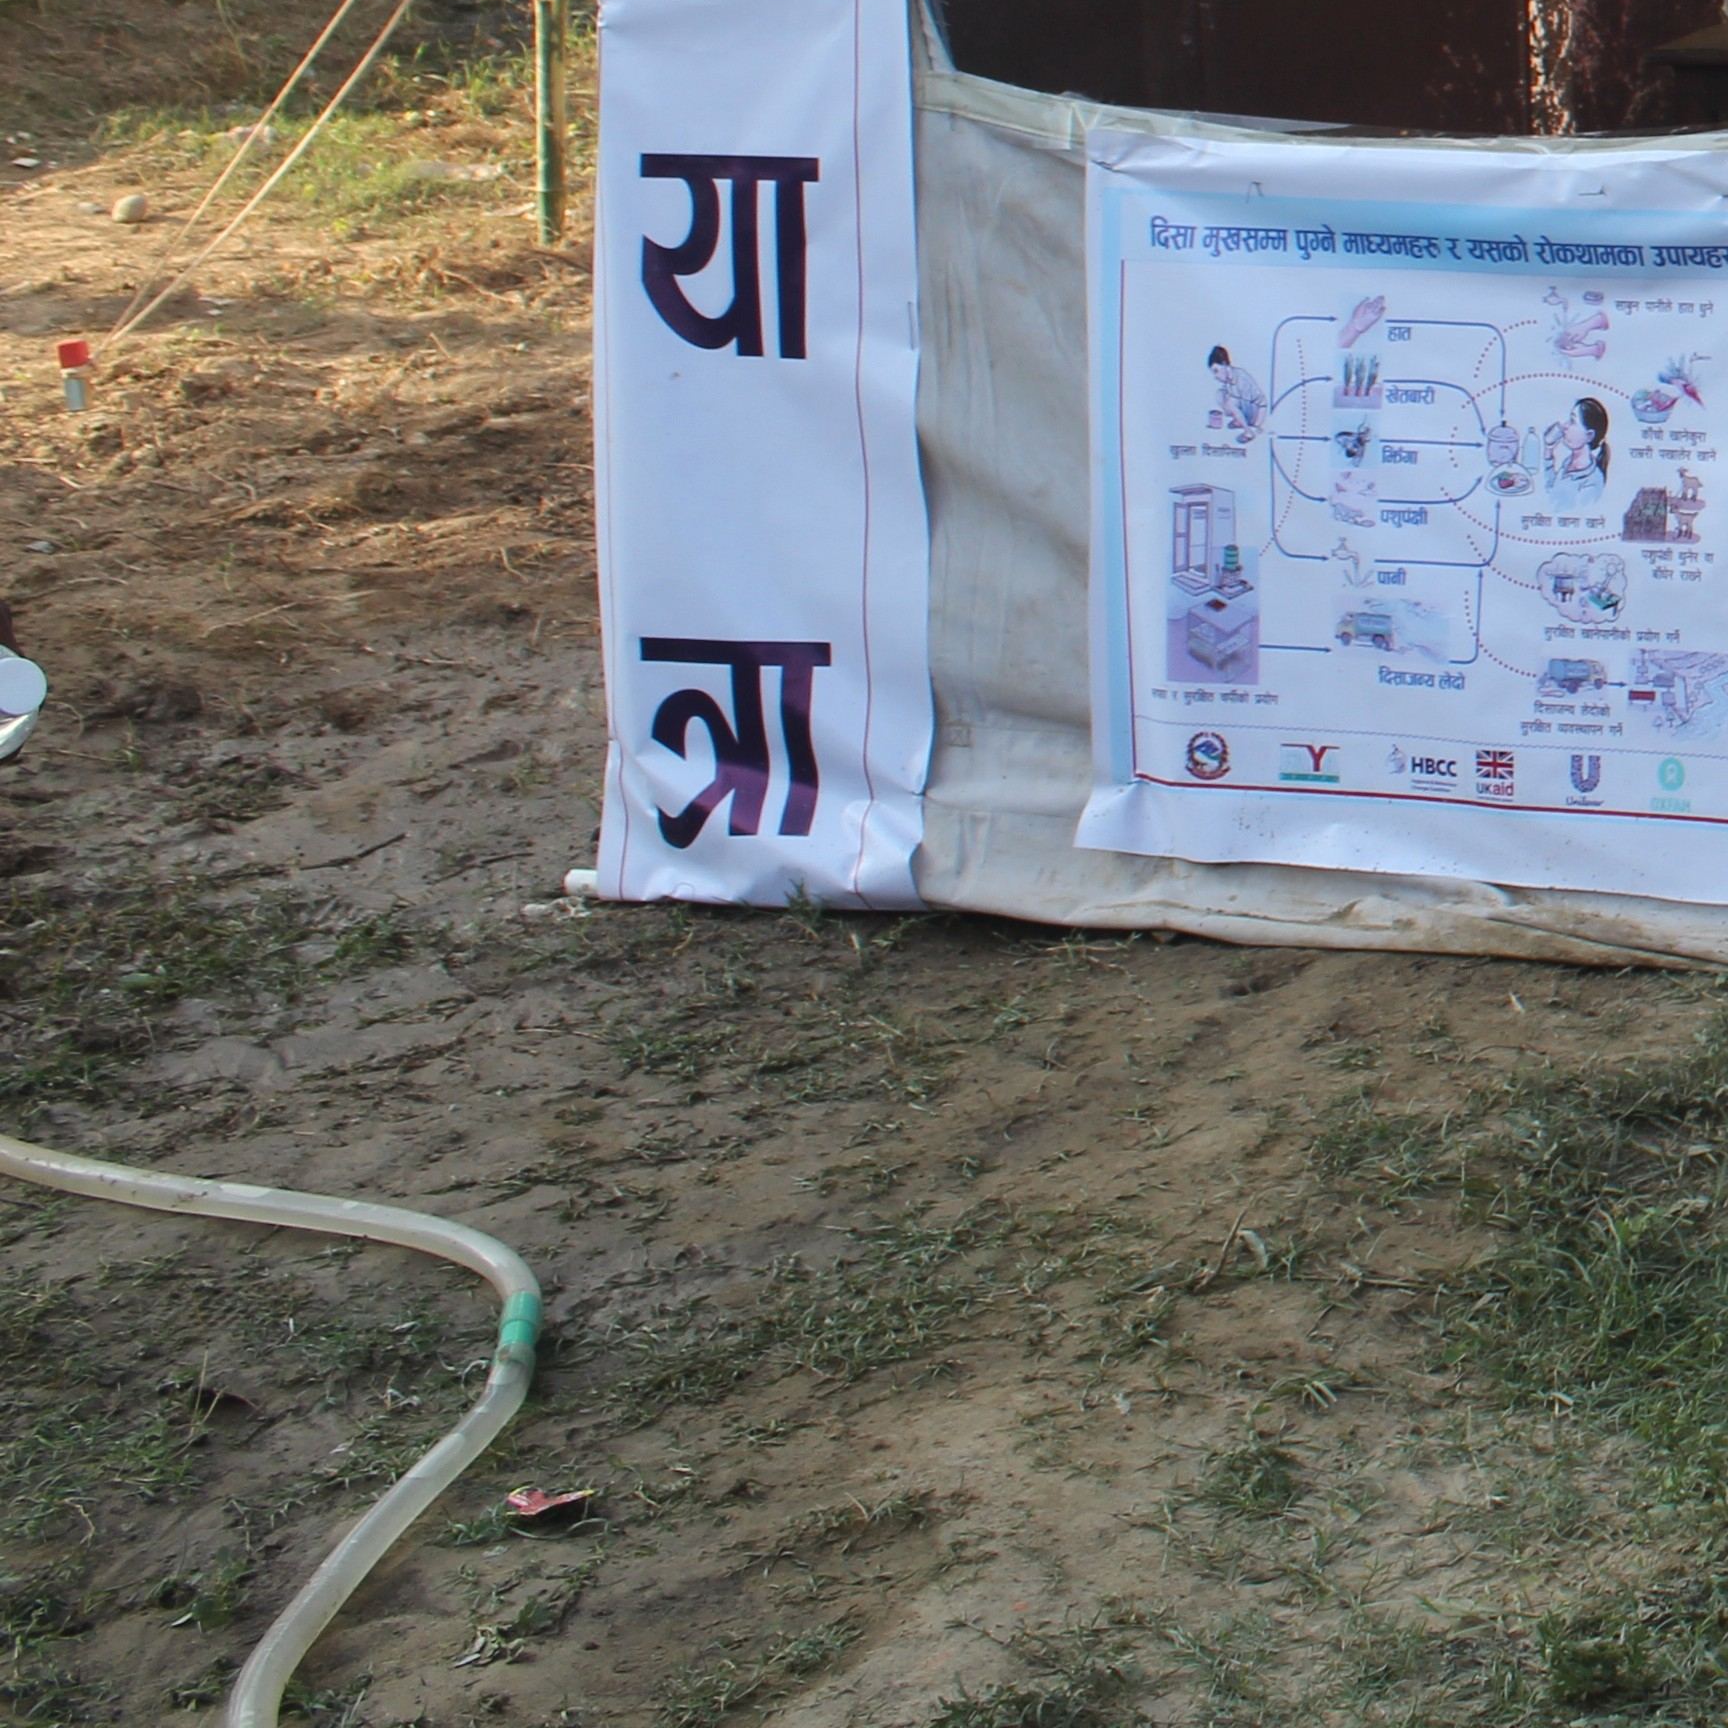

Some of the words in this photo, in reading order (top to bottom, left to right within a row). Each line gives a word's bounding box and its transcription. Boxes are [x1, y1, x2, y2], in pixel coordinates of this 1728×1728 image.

[1150, 216, 1198, 251] दिसा
[1203, 225, 1289, 258] मुखसम्म
[1295, 224, 1337, 260] पुग्ने
[1445, 238, 1462, 261] र
[1465, 234, 1529, 263] यसको
[1534, 235, 1646, 267] रोकथामका
[1411, 756, 1458, 777] HBCC
